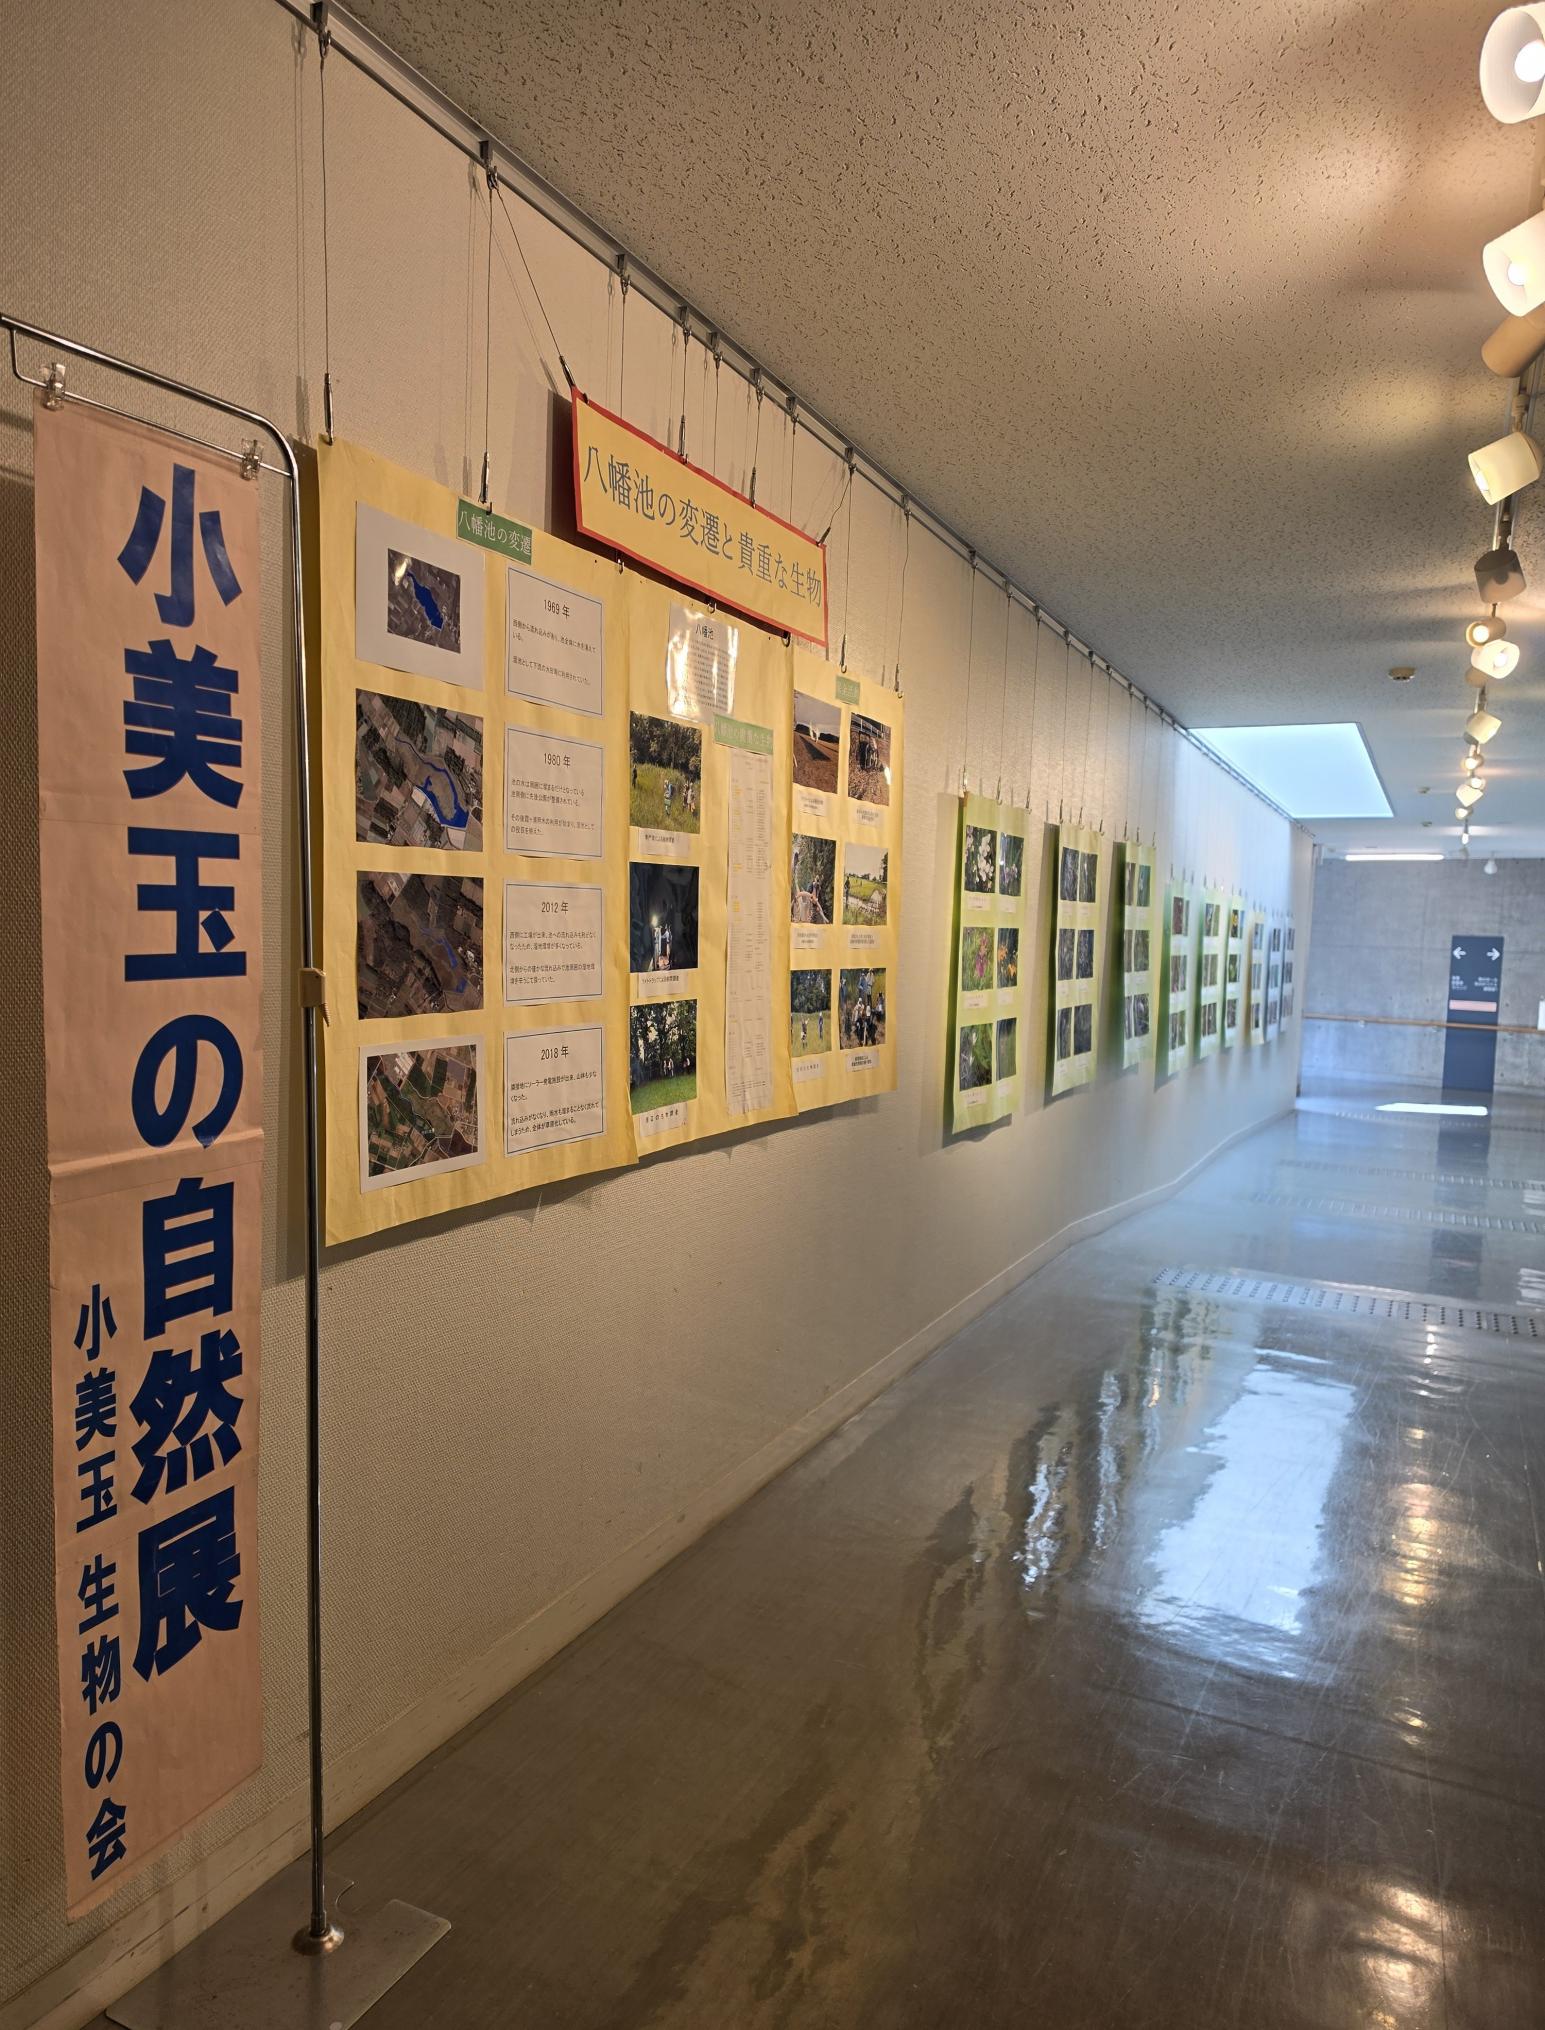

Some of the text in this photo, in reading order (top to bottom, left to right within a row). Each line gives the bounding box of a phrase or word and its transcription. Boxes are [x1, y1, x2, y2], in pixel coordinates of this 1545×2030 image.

[459, 511, 532, 555] 八幡池の変遷
[584, 446, 821, 608] 八幡池の変遷と貴重な生物
[544, 600, 570, 619] 1969 年
[544, 753, 571, 768] 1980 年
[541, 901, 569, 915] 2012 年
[541, 1045, 569, 1060] 2018 年
[117, 463, 247, 1683] 小美玉の自然展
